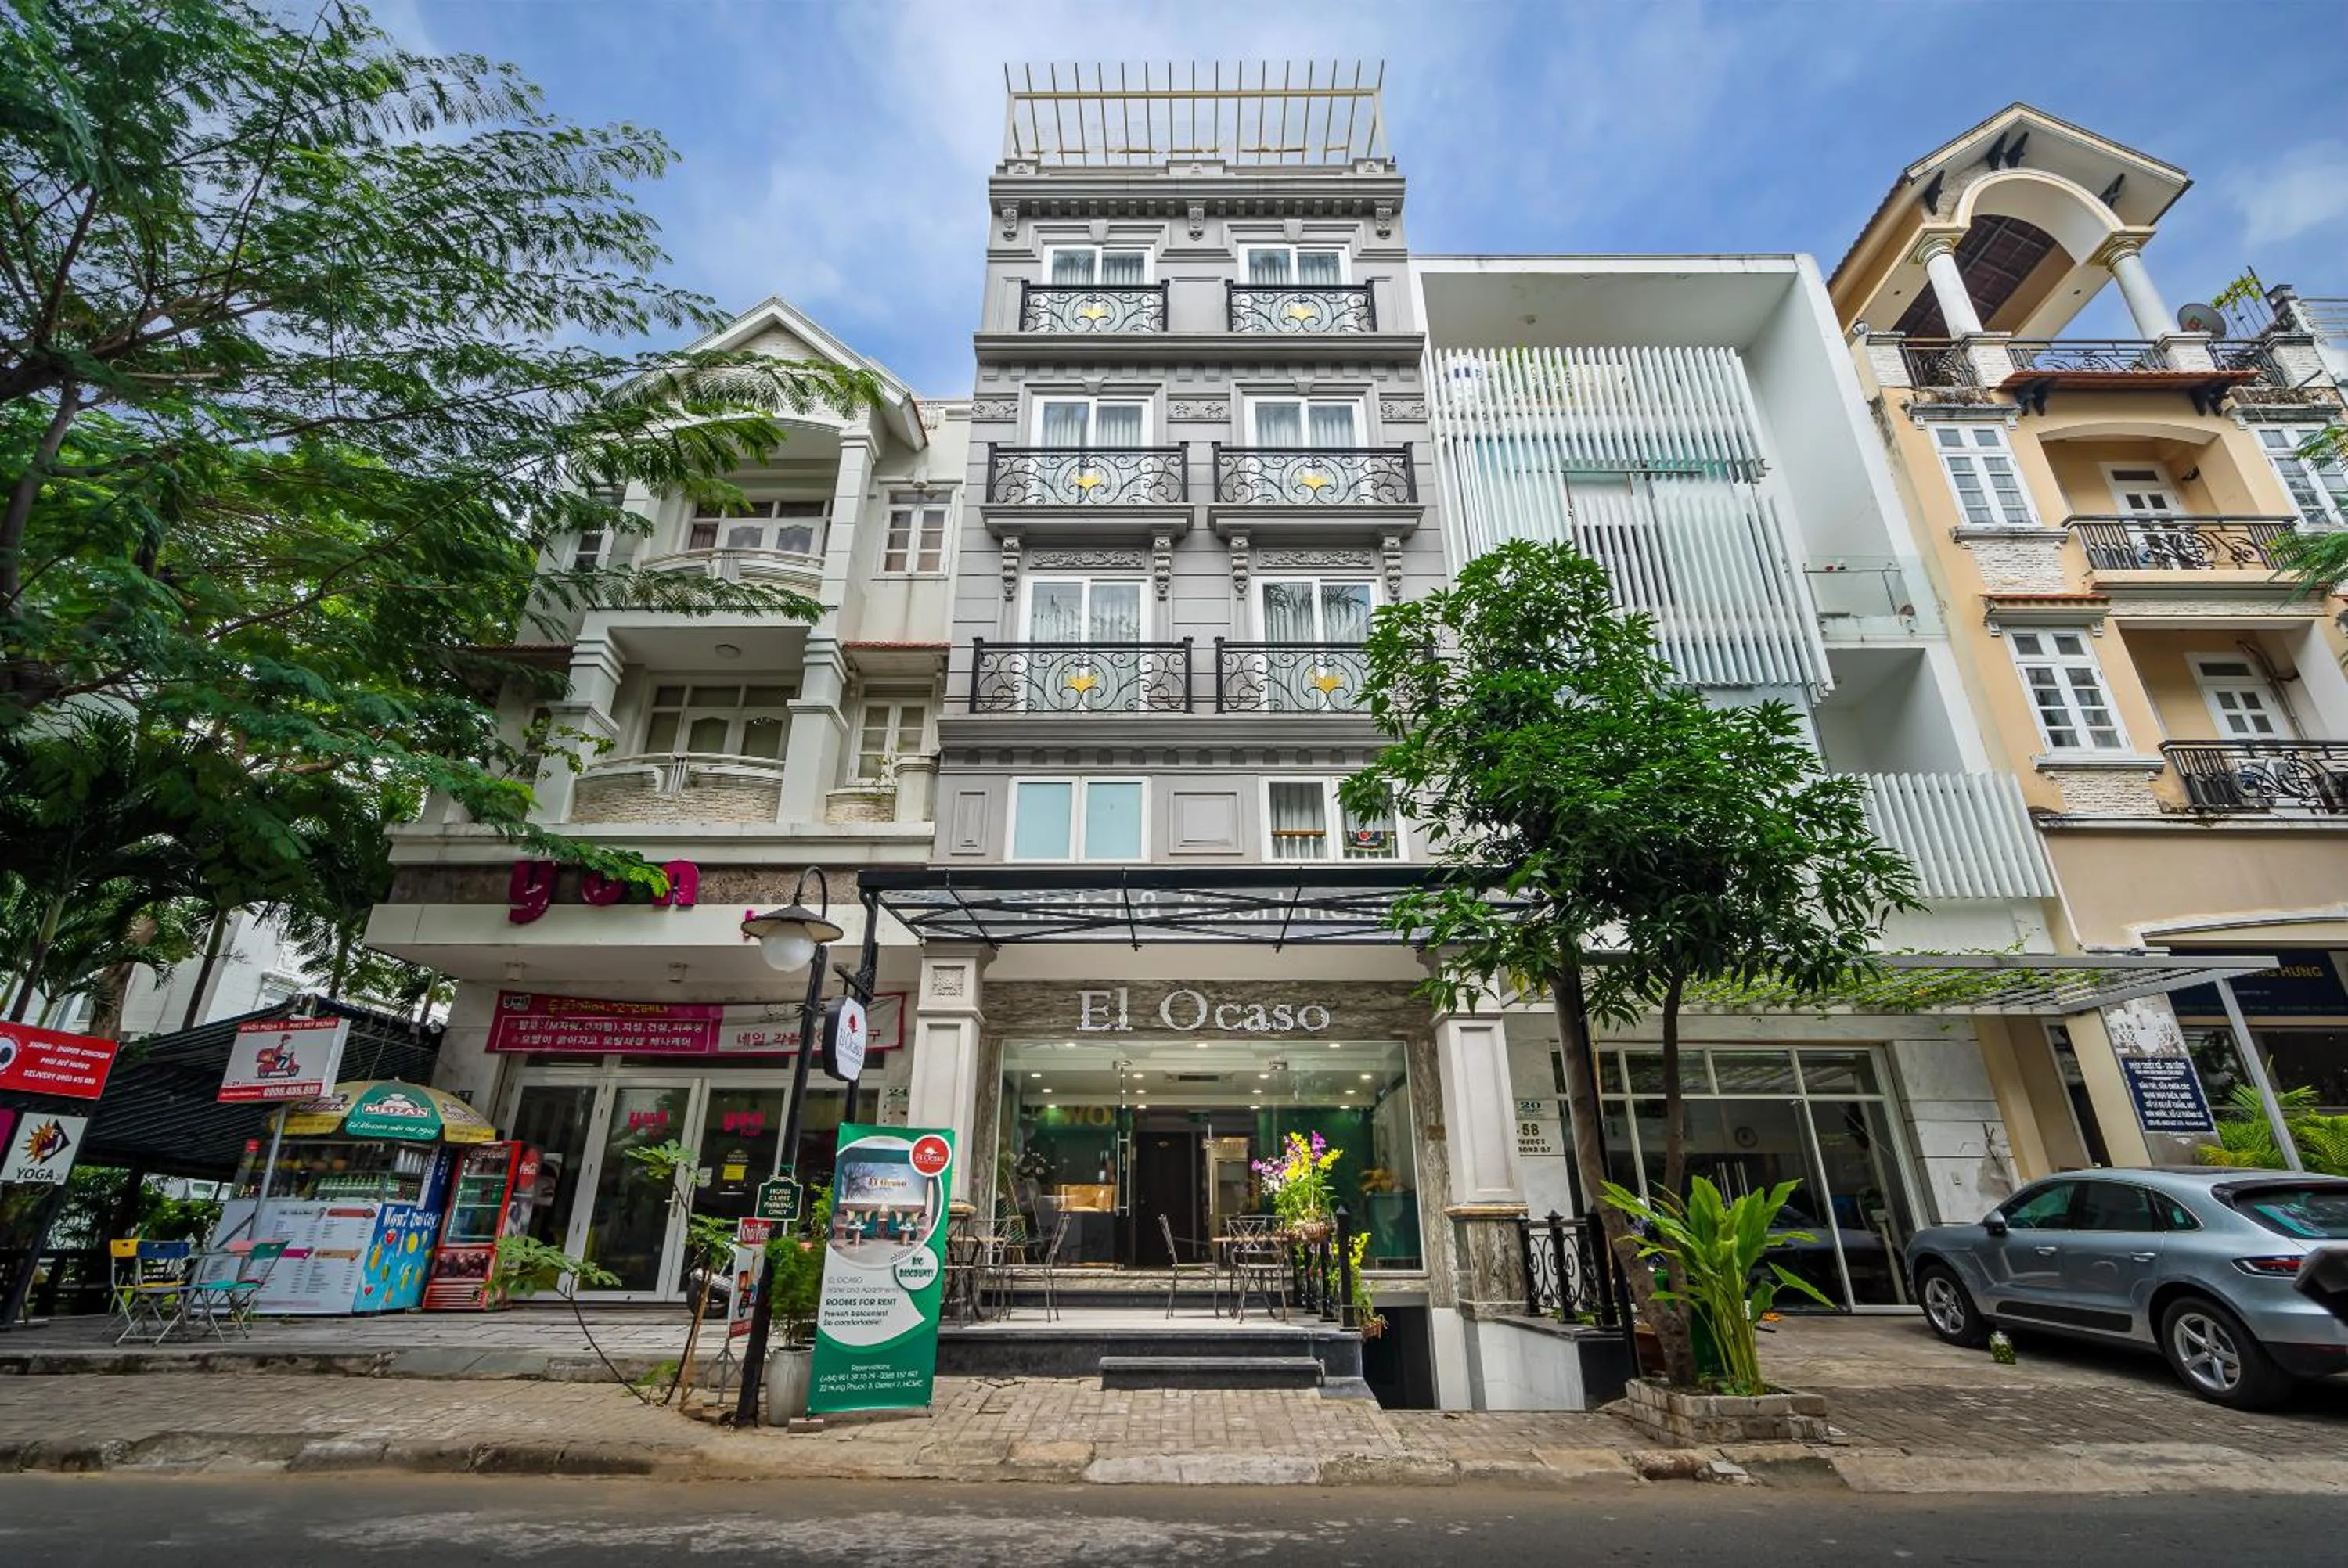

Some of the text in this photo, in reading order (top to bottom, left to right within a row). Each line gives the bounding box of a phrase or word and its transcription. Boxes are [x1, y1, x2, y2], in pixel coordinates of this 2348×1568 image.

[1076, 987, 1331, 1032] El Ocaso
[16, 1167, 55, 1181] YOGA
[837, 1276, 863, 1285] OCASO
